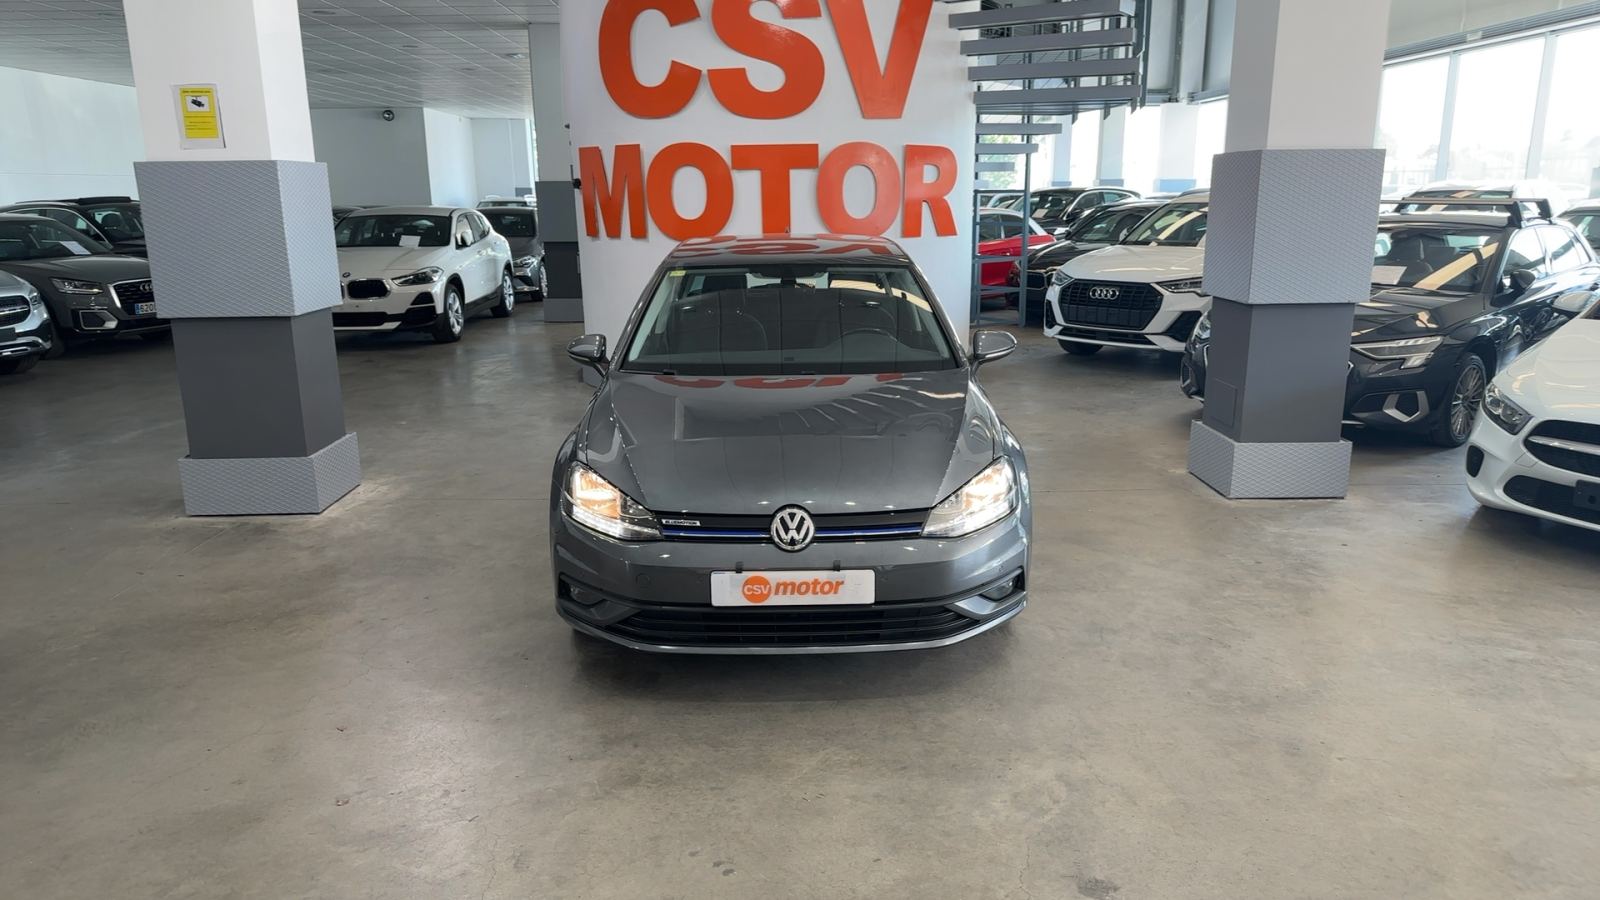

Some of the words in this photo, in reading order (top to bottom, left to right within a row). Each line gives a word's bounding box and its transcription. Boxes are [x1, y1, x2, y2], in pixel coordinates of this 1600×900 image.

[598, 0, 933, 119] CSV
[578, 141, 958, 240] MOTOR
[743, 584, 770, 595] CSV
[774, 578, 844, 596] motor
